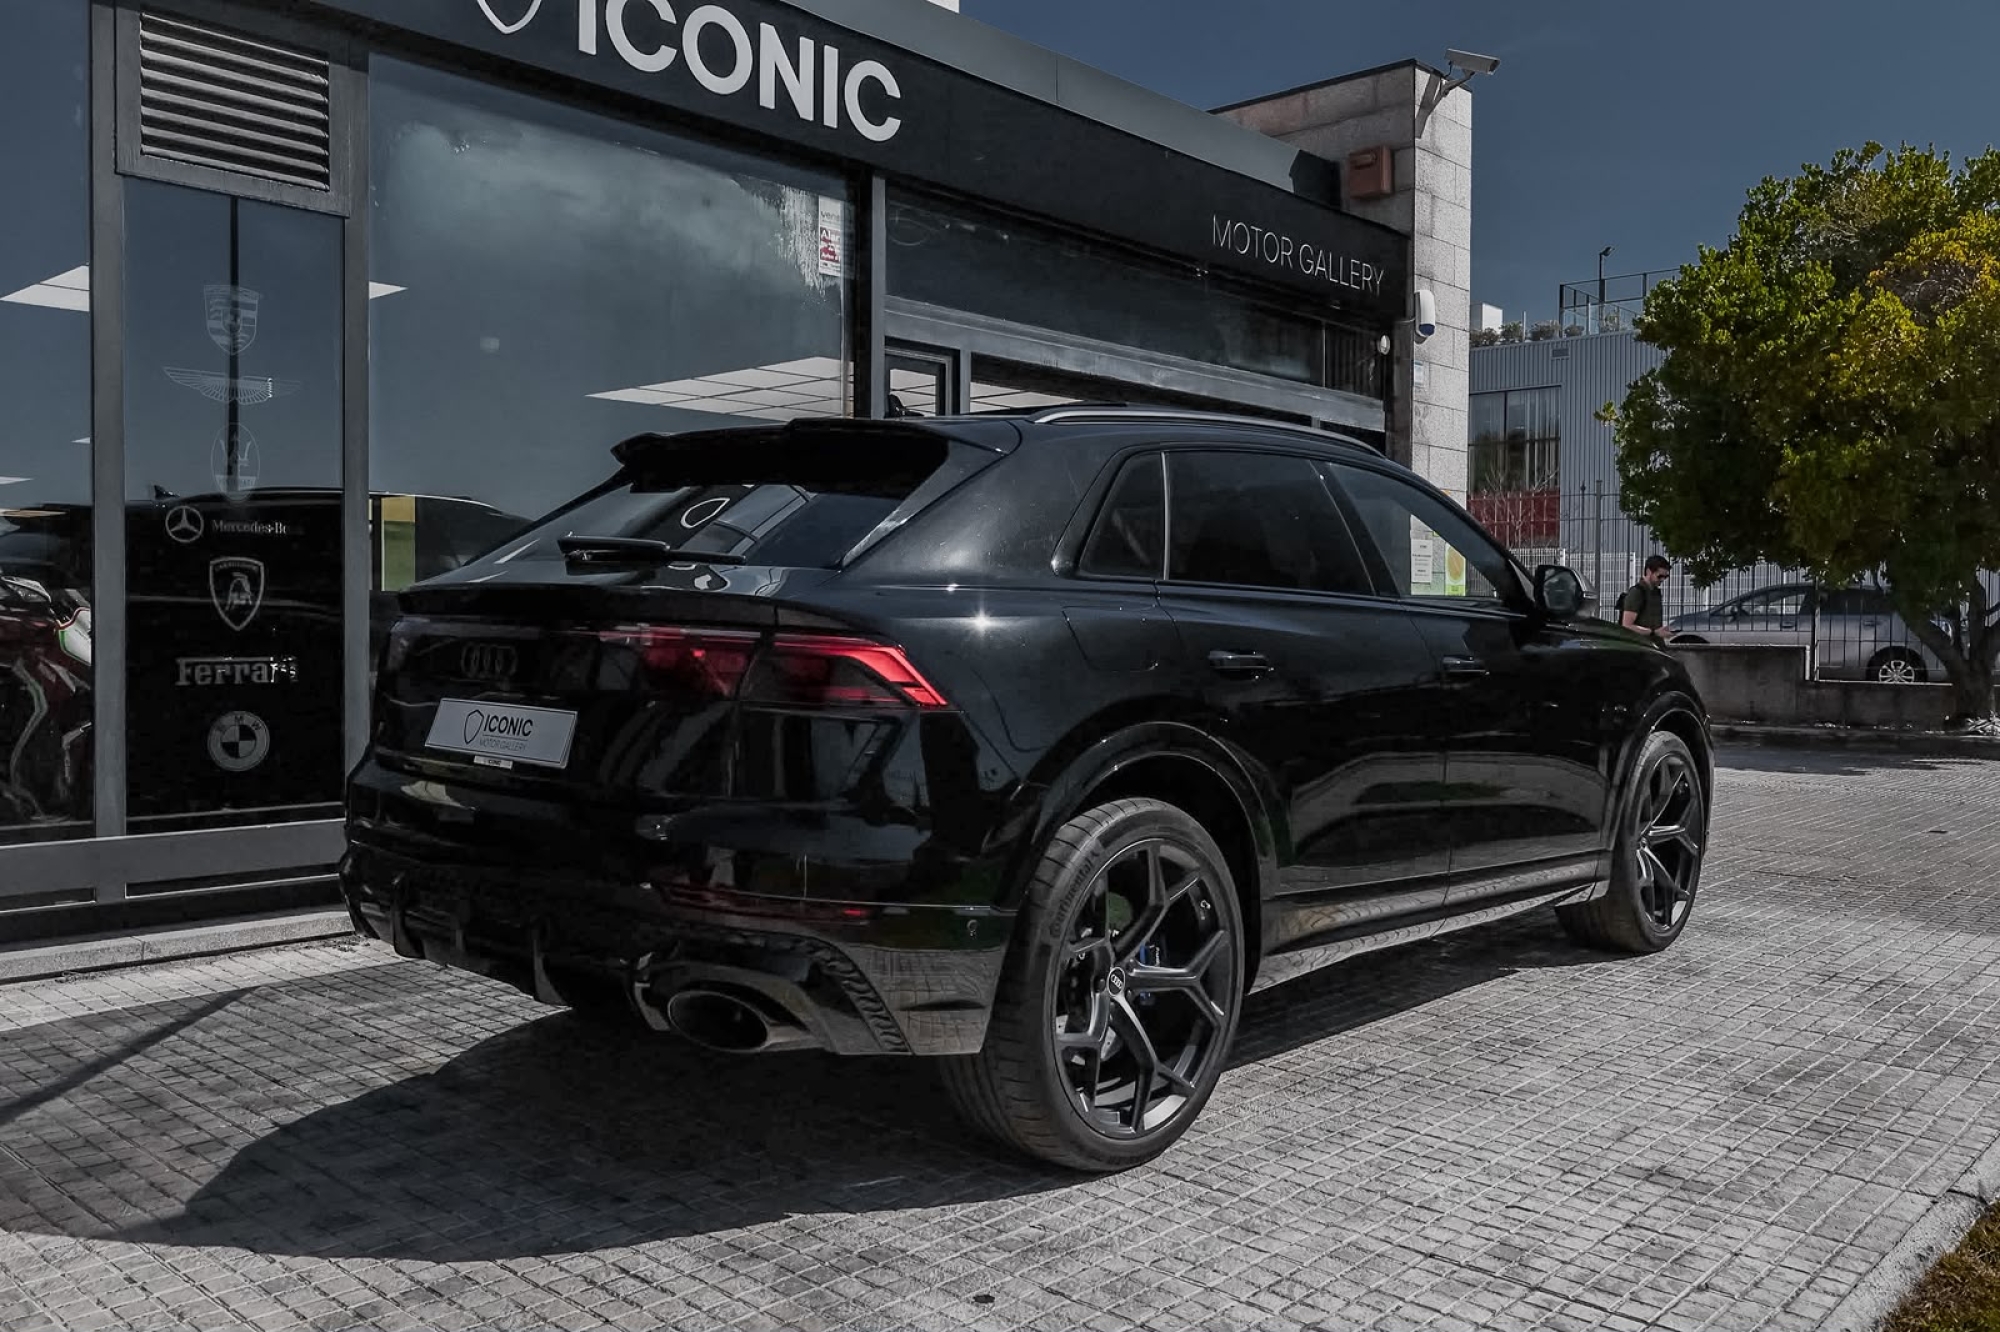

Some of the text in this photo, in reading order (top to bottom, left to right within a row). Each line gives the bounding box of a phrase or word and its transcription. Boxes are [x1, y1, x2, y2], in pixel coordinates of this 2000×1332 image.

[578, 0, 902, 142] ICONIC
[1213, 214, 1385, 296] MOTOR GALLERY
[483, 714, 534, 737] ICONIC
